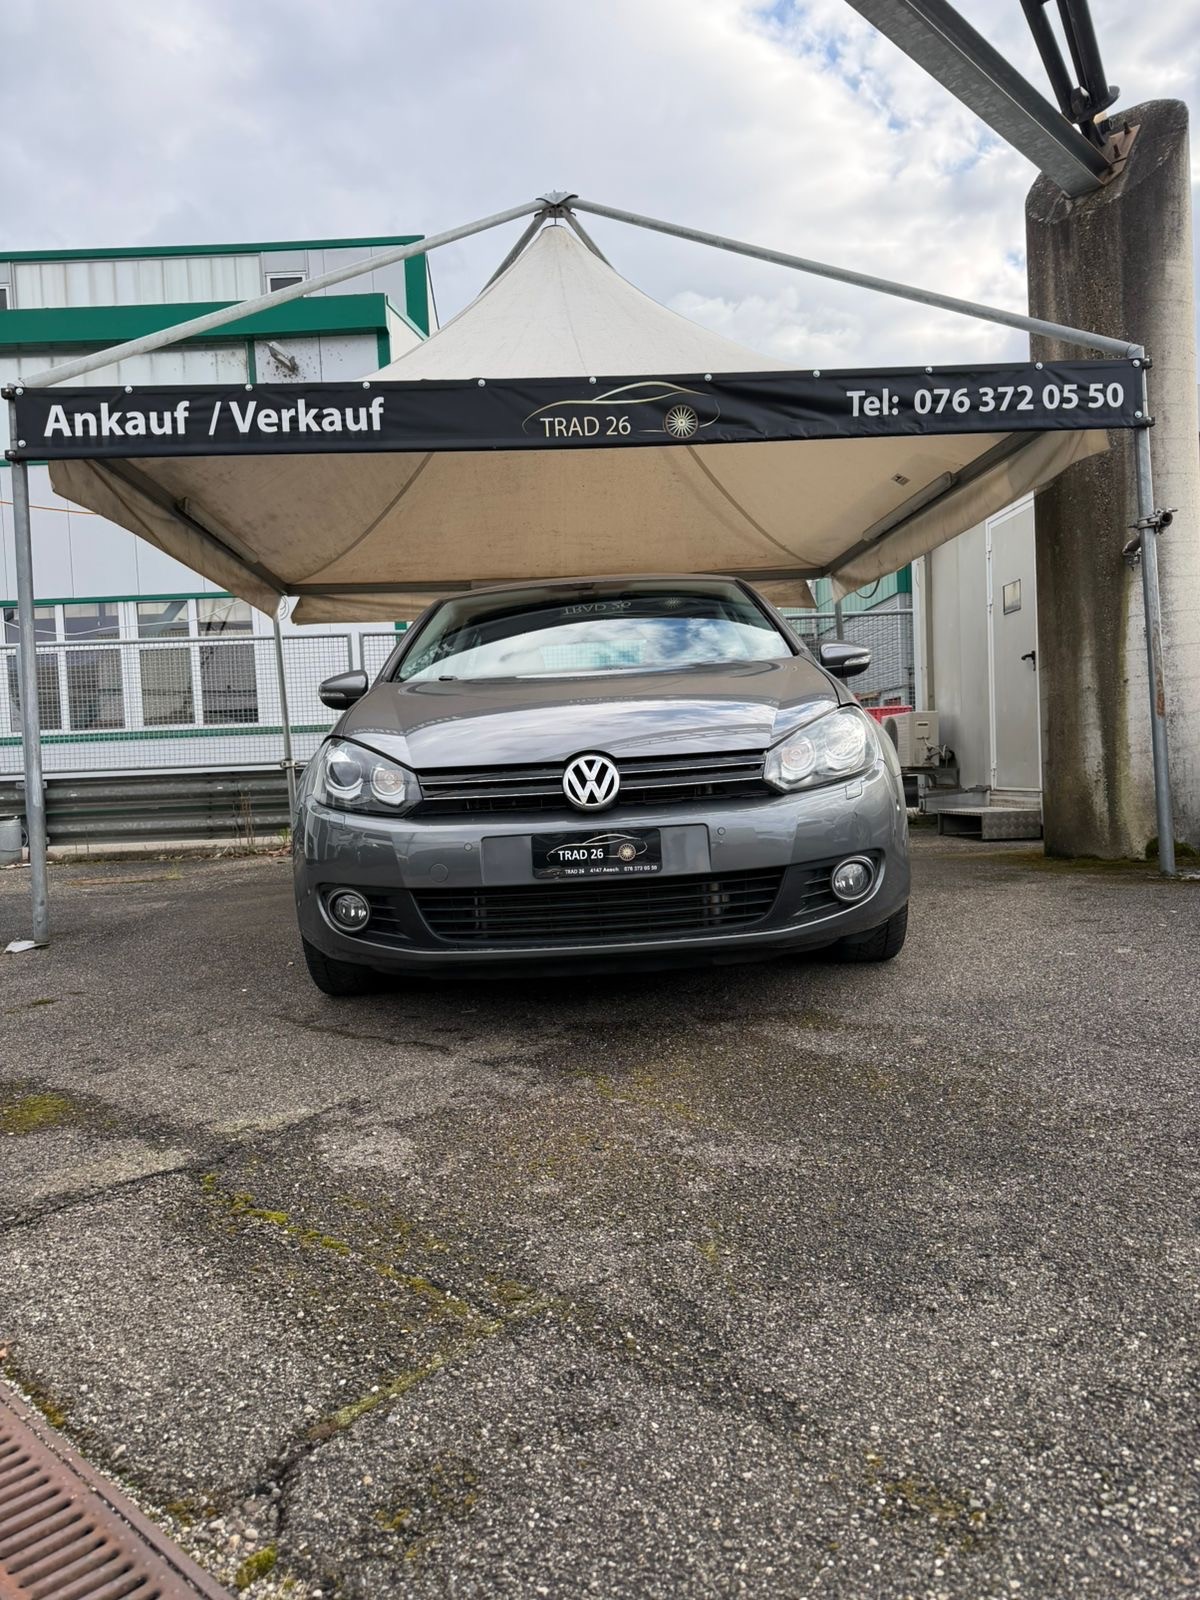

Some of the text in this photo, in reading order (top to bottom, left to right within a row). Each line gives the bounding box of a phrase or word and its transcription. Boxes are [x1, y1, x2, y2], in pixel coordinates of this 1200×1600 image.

[846, 382, 1124, 417] Tel: 076 372 05 50
[44, 401, 190, 437] Ankauf
[540, 416, 631, 437] TRAD 26
[563, 755, 620, 808] VW
[558, 848, 604, 861] TRAD 26
